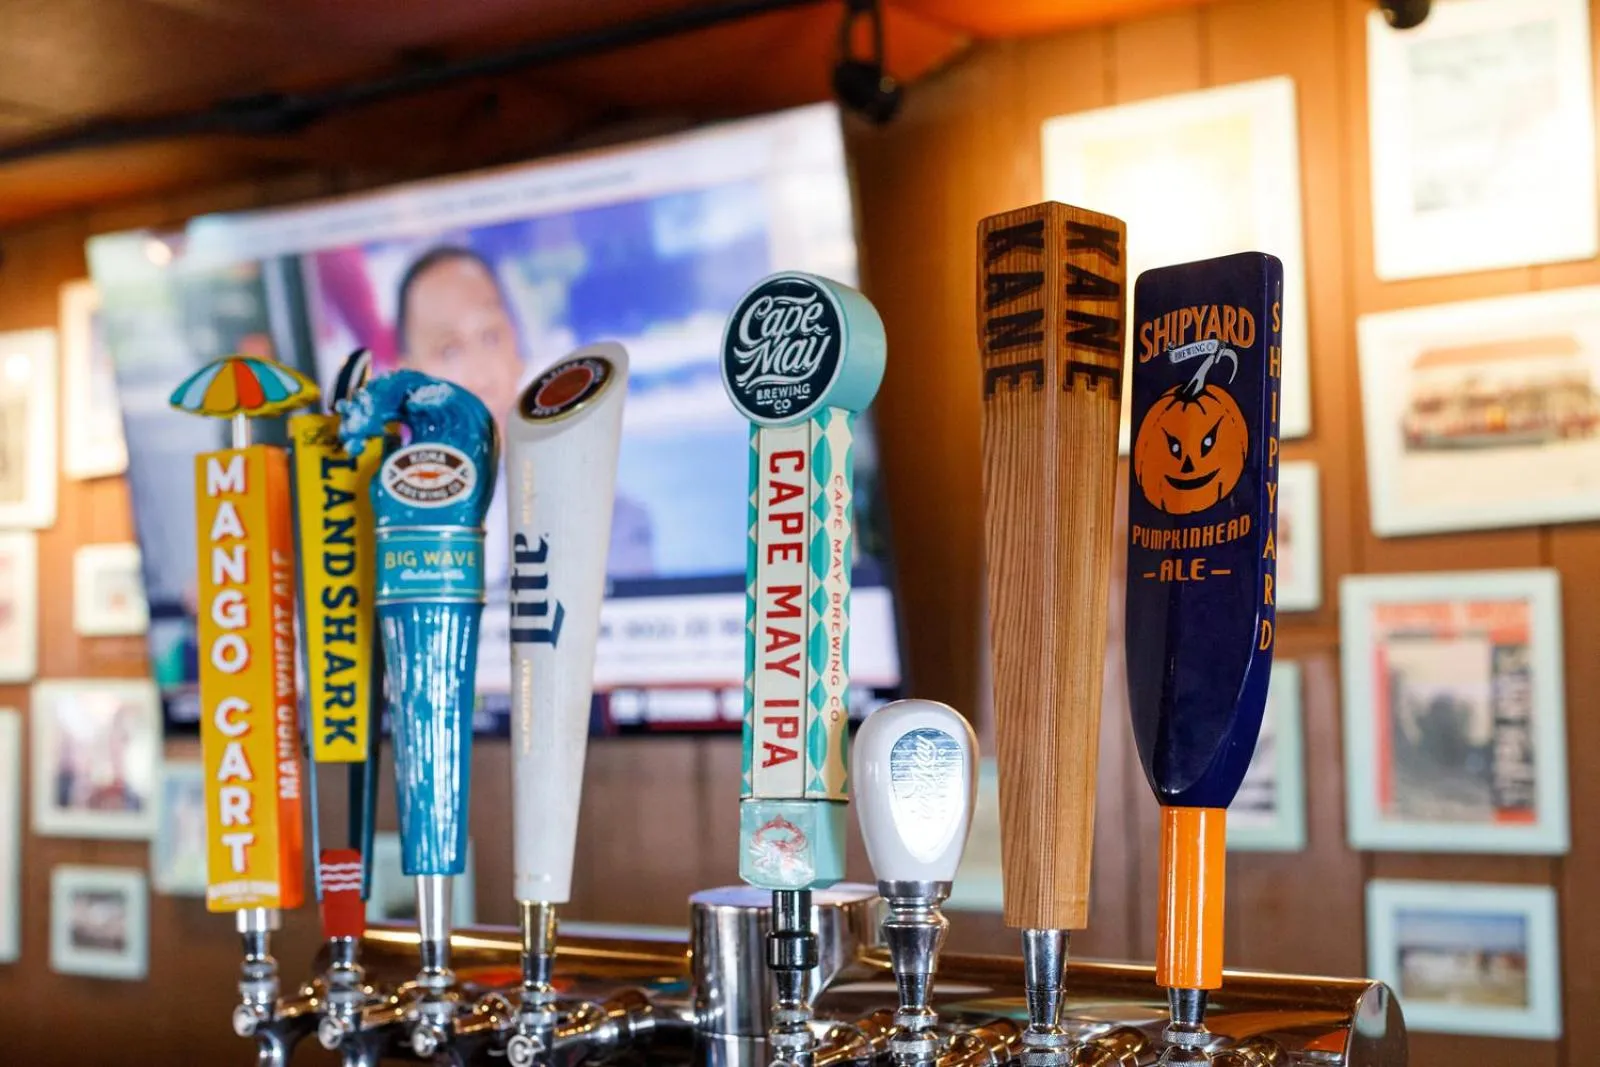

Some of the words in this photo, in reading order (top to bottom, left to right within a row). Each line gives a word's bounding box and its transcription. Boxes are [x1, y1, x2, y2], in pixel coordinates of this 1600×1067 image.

[739, 292, 830, 347] Cape
[984, 219, 1045, 399] KANE
[1064, 220, 1121, 400] KANE
[1139, 304, 1256, 364] SHIPYARD
[734, 335, 832, 390] May
[756, 384, 811, 401] BREWING
[774, 399, 792, 411] CO
[767, 450, 804, 565] CAPE
[833, 474, 844, 530] CAPE
[1259, 302, 1281, 650] SHIPYARD
[206, 454, 249, 674] MANGO
[384, 551, 417, 569] BIG
[422, 551, 476, 567] WAVE
[831, 539, 843, 584] MAY
[1132, 514, 1251, 550] PUMPKINHEAD
[320, 456, 359, 746] LANDSHARK
[510, 532, 565, 650] Lite
[764, 585, 803, 679] MAY
[830, 592, 842, 686] BREWING
[762, 699, 800, 769] IPA
[214, 697, 253, 873] CART
